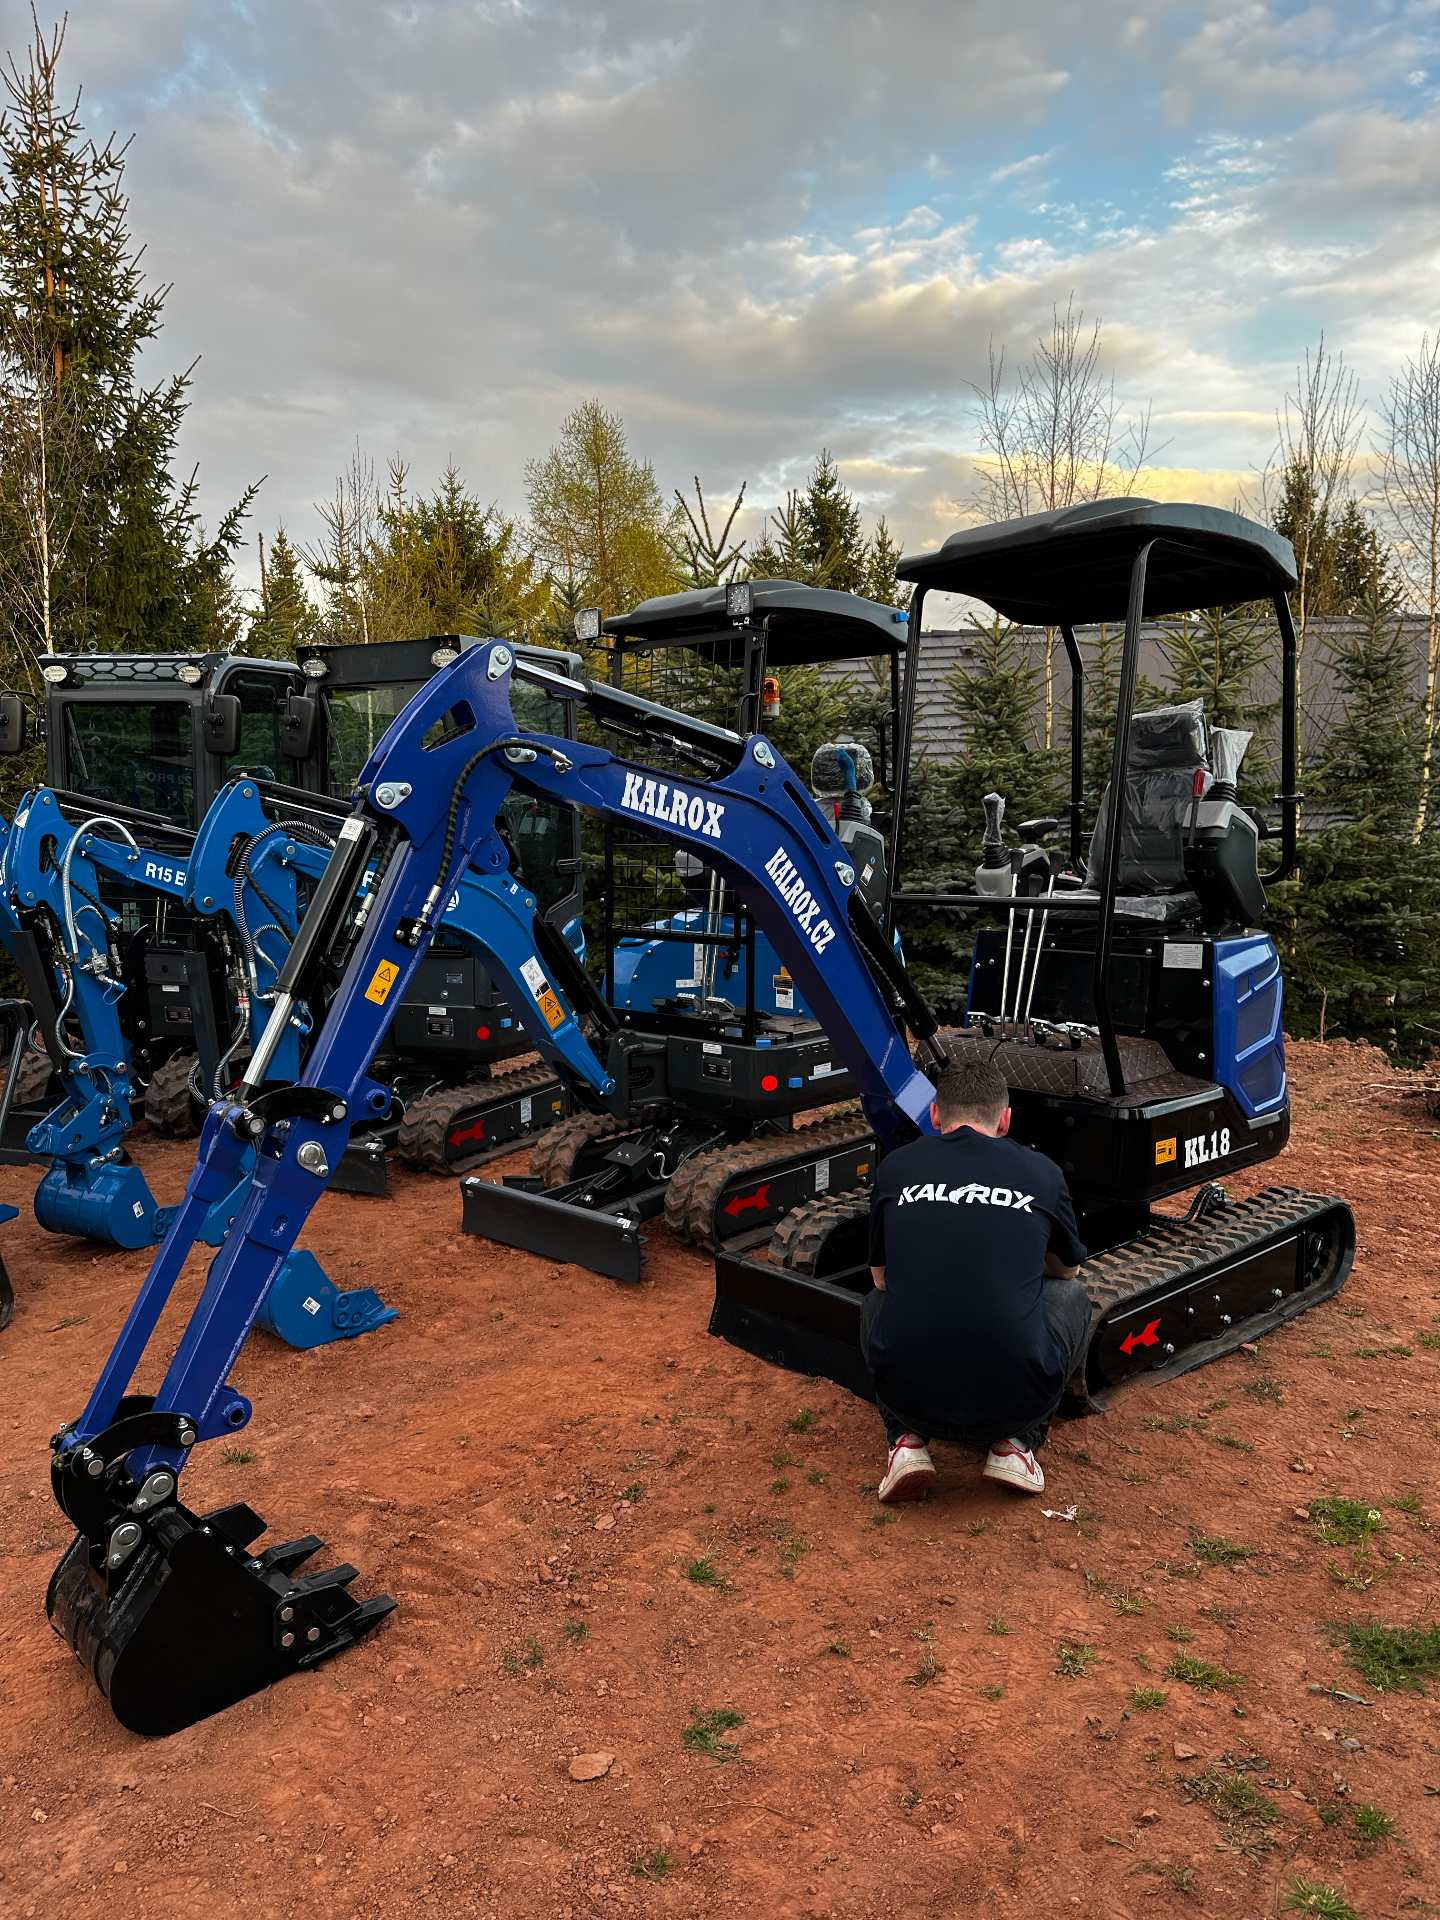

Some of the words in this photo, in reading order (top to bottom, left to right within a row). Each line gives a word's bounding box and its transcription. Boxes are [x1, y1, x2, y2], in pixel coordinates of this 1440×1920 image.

[621, 772, 726, 838] KALROX
[145, 862, 173, 883] R15
[174, 870, 187, 887] E
[764, 847, 836, 954] KALROX.CZ
[1184, 1127, 1231, 1169] KL18
[897, 1183, 1036, 1213] KALROX
